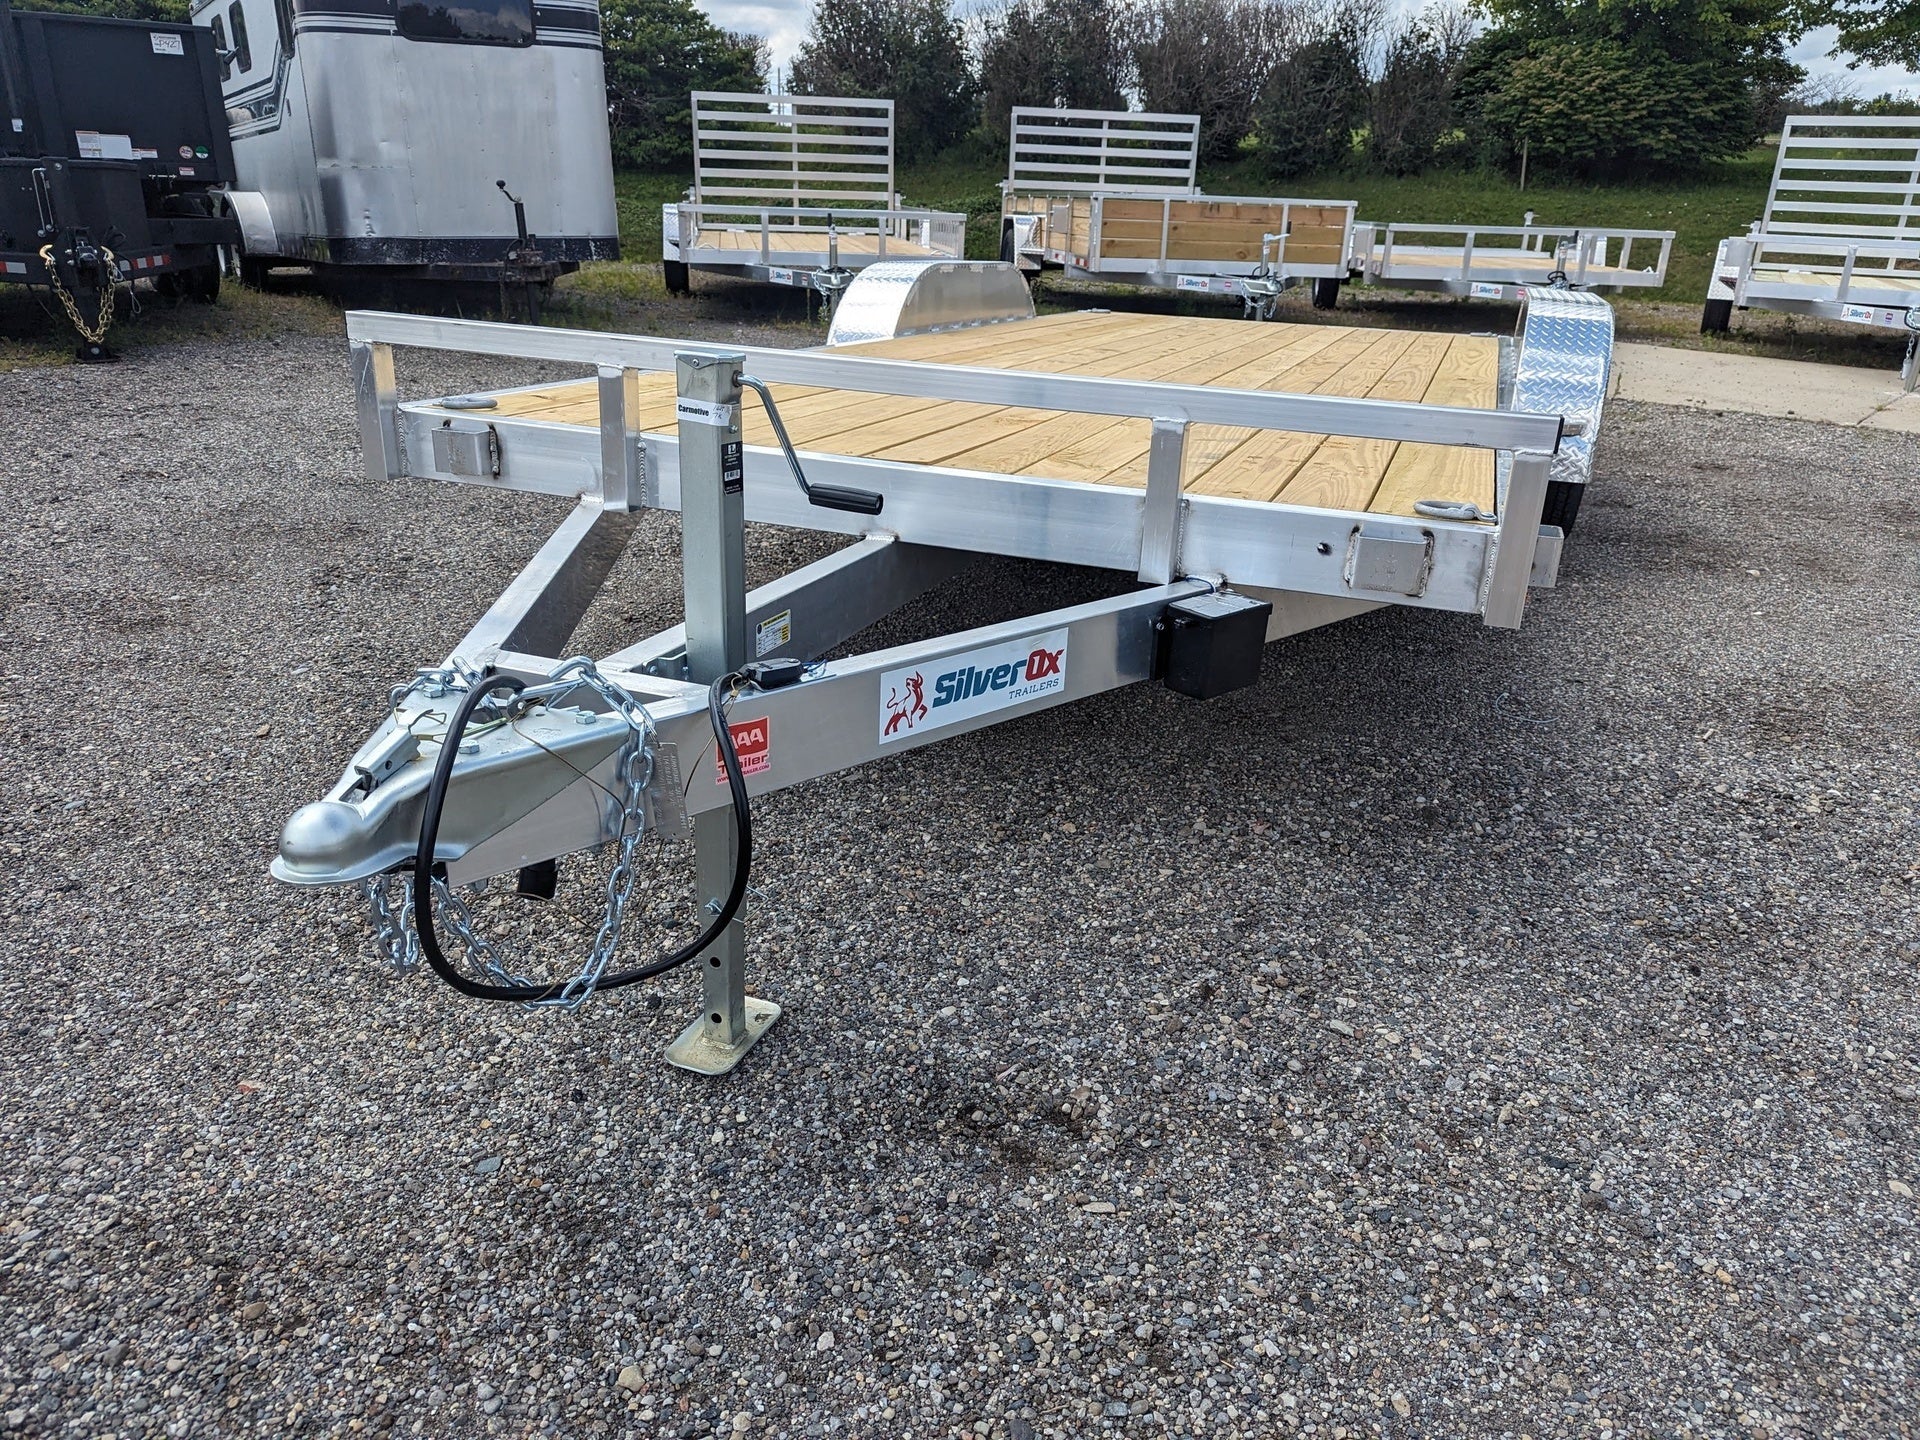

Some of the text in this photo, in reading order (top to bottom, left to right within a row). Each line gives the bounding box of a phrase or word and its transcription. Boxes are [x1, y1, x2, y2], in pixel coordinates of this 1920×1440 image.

[678, 404, 710, 416] Carmotive
[932, 649, 1065, 708] SilverOx
[1008, 678, 1060, 700] TRAILERS
